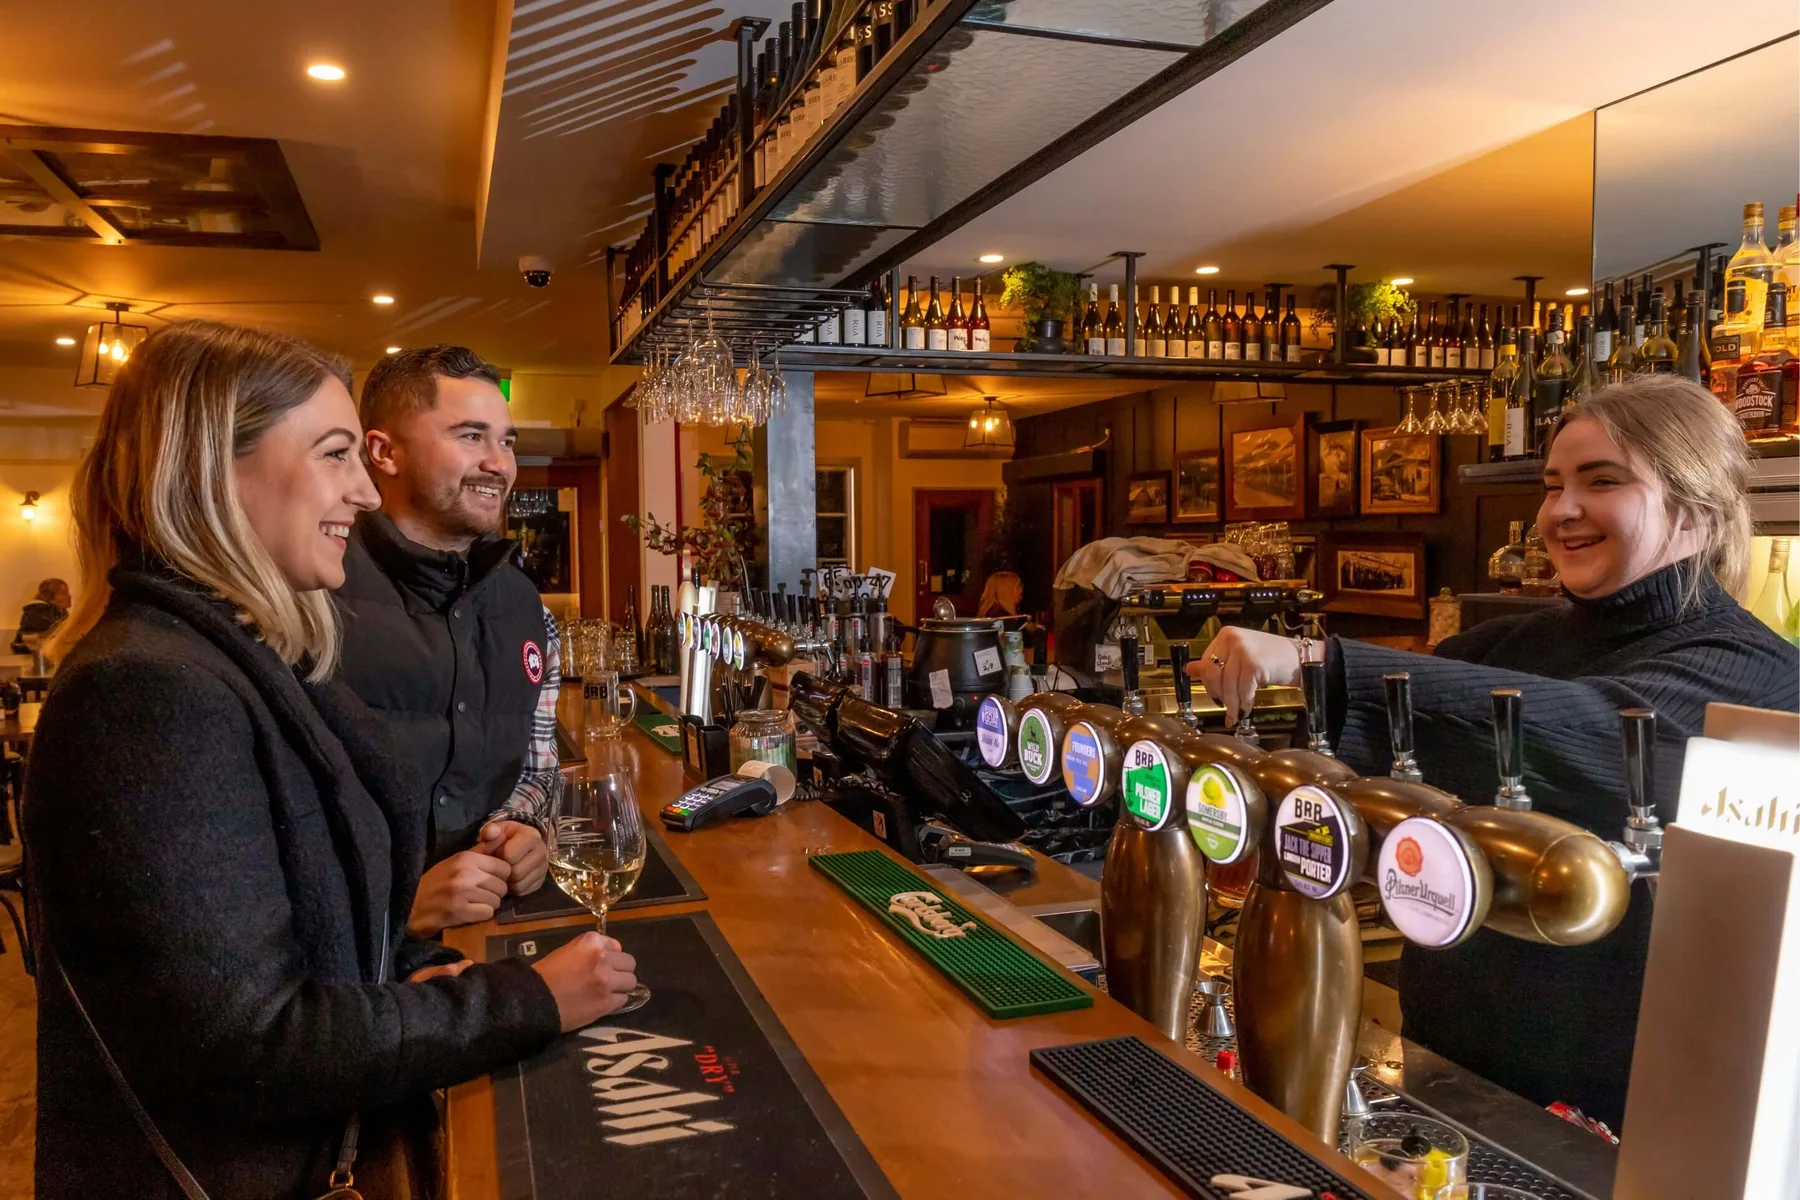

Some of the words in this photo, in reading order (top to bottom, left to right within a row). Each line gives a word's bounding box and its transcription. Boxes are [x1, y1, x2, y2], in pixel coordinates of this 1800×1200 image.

[1023, 748, 1043, 766] BUCK
[1026, 741, 1040, 752] WILD
[1072, 740, 1097, 759] FOUNDERS
[1135, 749, 1154, 771] BRB
[1135, 782, 1161, 806] PILSNER
[1140, 798, 1161, 820] LAGER
[1198, 802, 1228, 821] SOMERSBY
[1294, 797, 1323, 822] BRB
[1284, 834, 1299, 854] JACK
[1299, 838, 1310, 857] THE
[1310, 842, 1332, 865] SIPPER
[1300, 857, 1332, 884] PORTER
[1385, 868, 1420, 900] Pilsner
[1419, 879, 1456, 911] Urquell
[578, 1027, 737, 1146] Asahi
